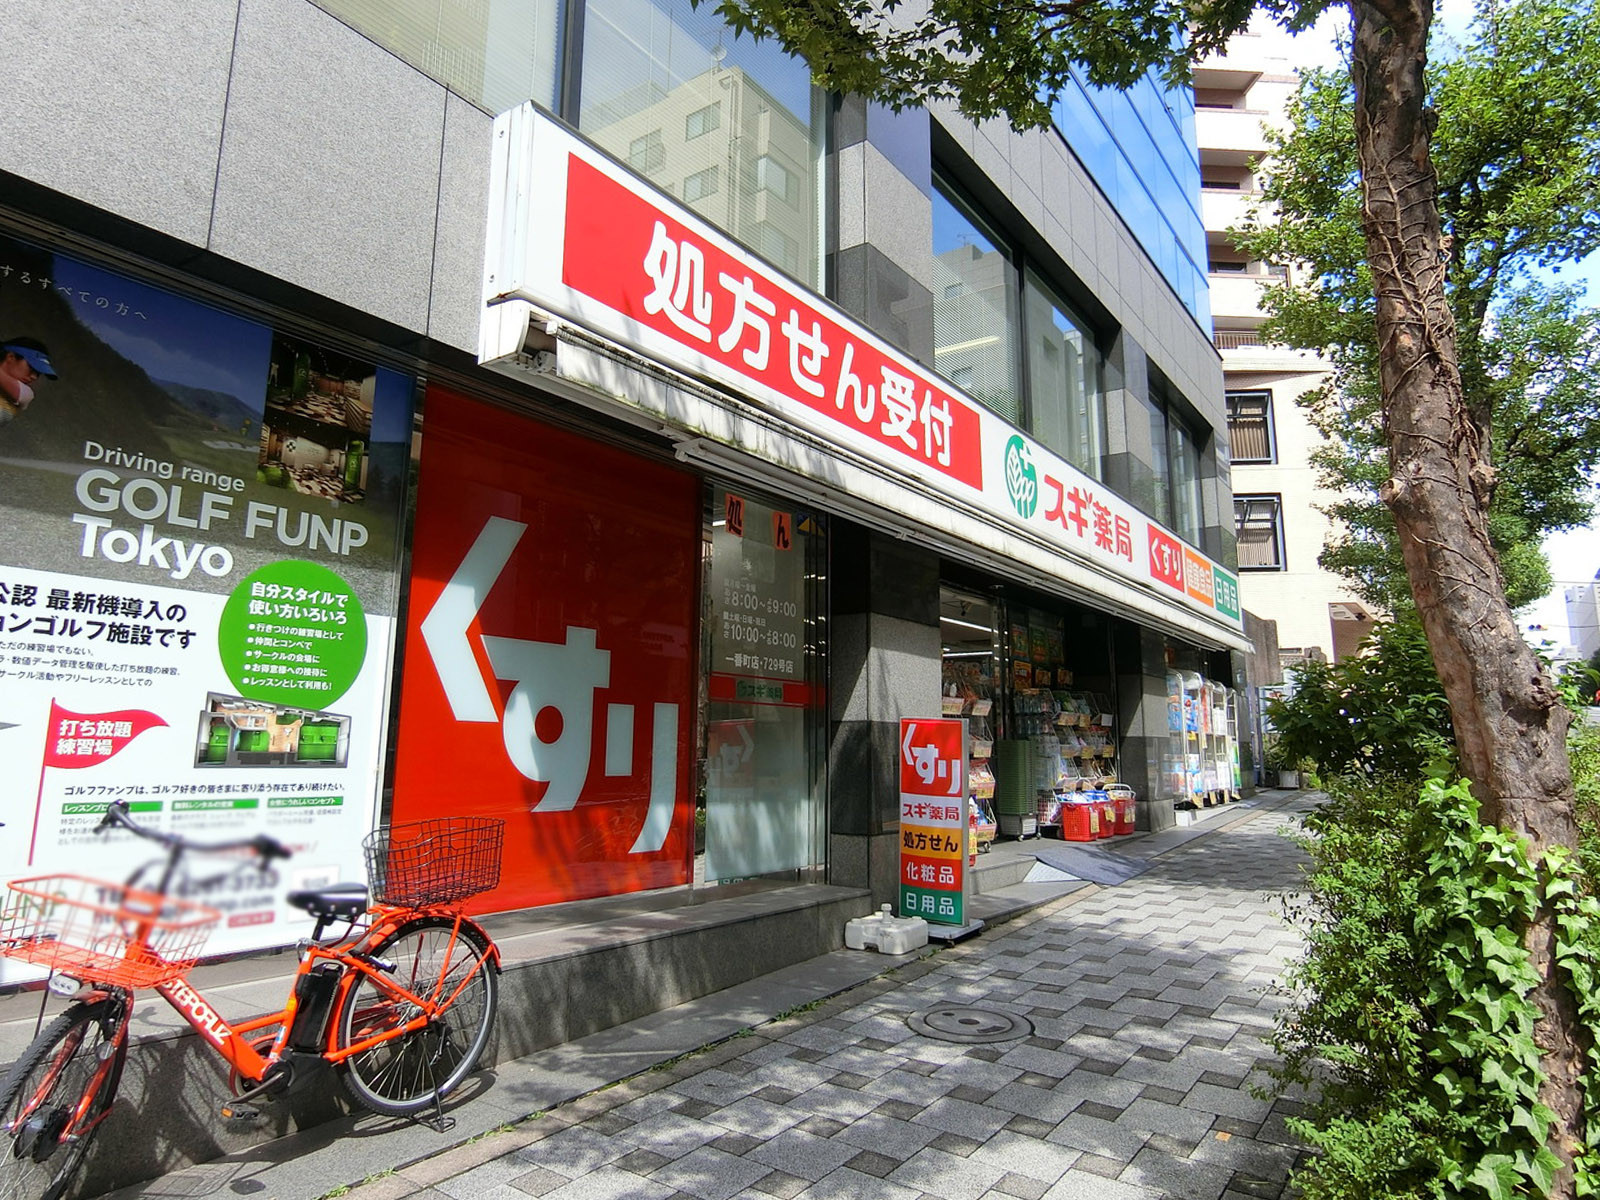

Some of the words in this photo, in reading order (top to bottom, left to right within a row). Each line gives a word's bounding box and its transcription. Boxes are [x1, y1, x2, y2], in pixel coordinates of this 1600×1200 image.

[642, 220, 953, 467] 処方せん受付
[84, 440, 173, 480] Driving
[181, 465, 245, 492] range
[76, 468, 234, 531] GOLF
[245, 500, 368, 556] FUNP
[1044, 473, 1133, 562] スギ薬局
[72, 513, 234, 580] Tokyo
[776, 513, 790, 549] ん
[1151, 537, 1182, 582] くすり
[46, 588, 187, 623] 最新機導入の
[248, 599, 347, 625] 使い方いろいろ
[251, 581, 349, 608] 自分スタイルで
[1215, 576, 1238, 613] 日用品
[420, 515, 679, 854] くすり
[60, 719, 133, 738] 打ち放題
[56, 738, 113, 756] 練習場
[902, 723, 961, 794] くすり
[903, 802, 960, 821] スギ薬局
[903, 830, 958, 853] 処方せん
[906, 861, 955, 885] 化粧品
[906, 892, 955, 916] 日用品
